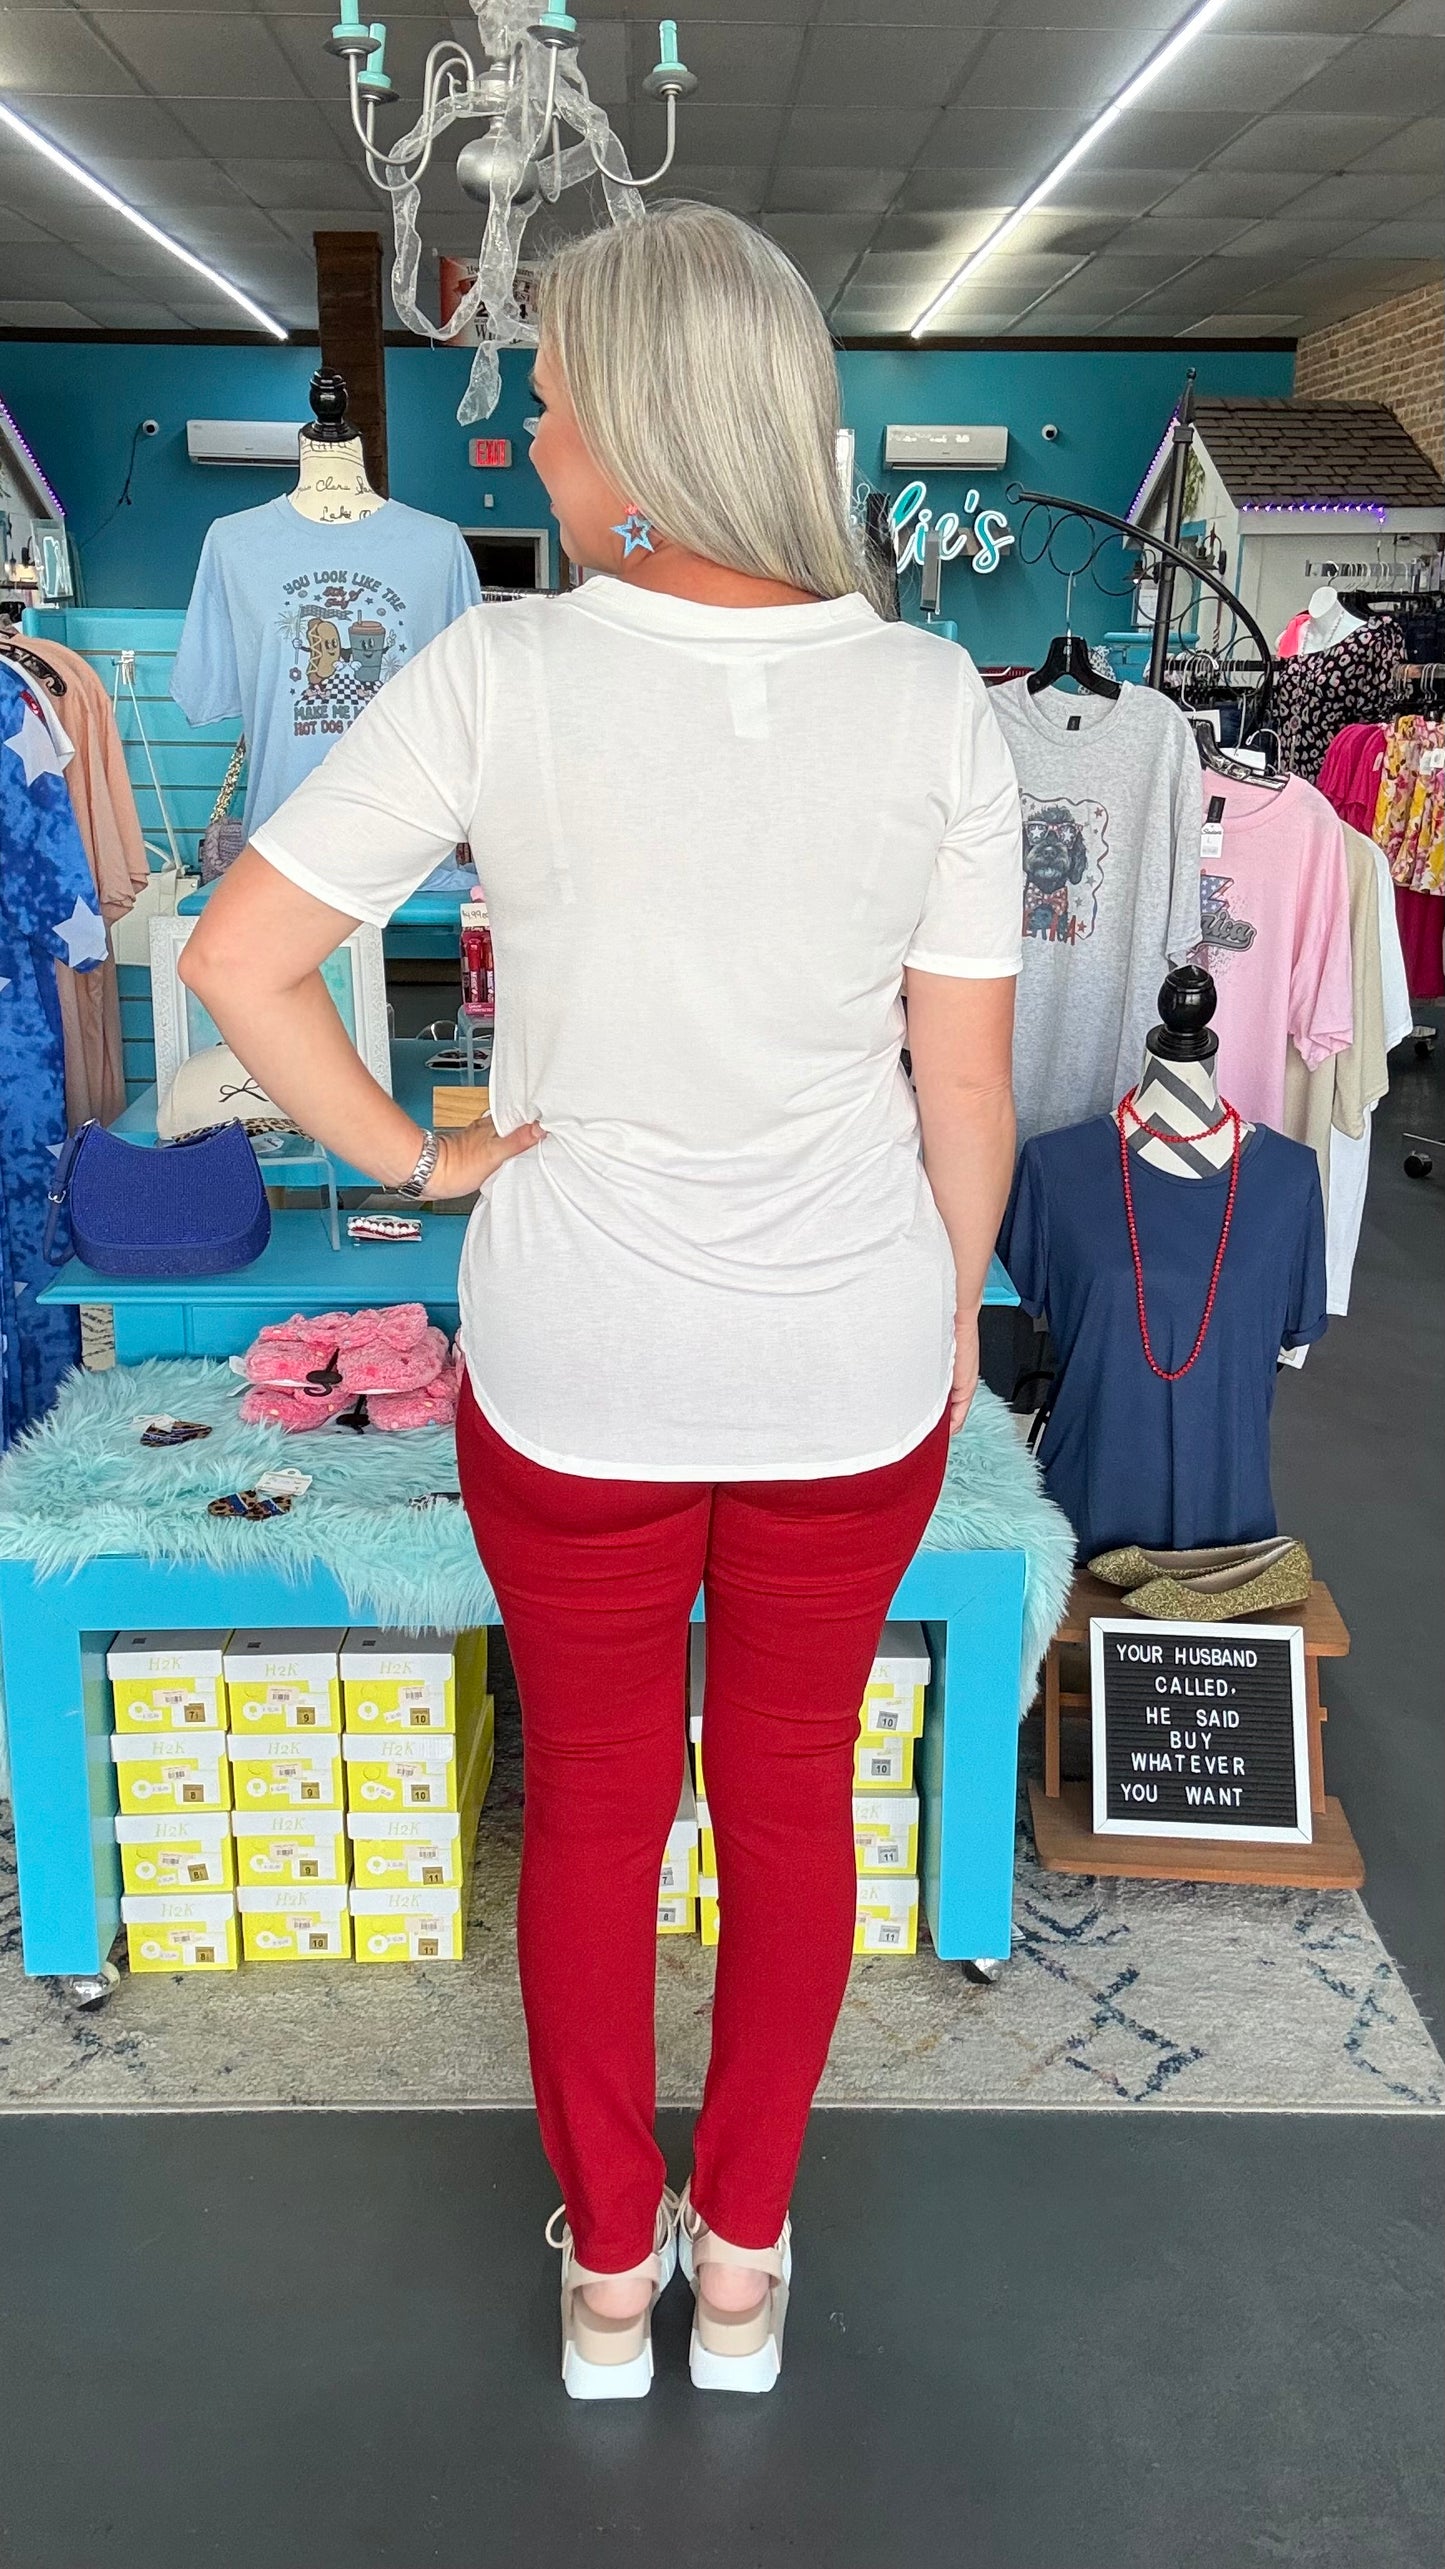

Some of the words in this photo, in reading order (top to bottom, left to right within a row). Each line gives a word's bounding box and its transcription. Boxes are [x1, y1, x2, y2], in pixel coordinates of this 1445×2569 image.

[476, 439, 506, 466] EXIT
[283, 574, 310, 595] YOU
[313, 570, 348, 584] LOOK
[352, 572, 382, 592] LIKE
[381, 587, 406, 612] THE
[294, 705, 329, 721] MAKE
[332, 704, 351, 719] ME
[294, 721, 317, 736] HOT
[320, 720, 344, 734] DOG
[1116, 1643, 1163, 1664] YOUR
[1174, 1647, 1258, 1668] HUSBAND
[415, 1715, 426, 1723] 10
[882, 1718, 893, 1727] 10
[1146, 1706, 1172, 1725] HE
[1196, 1709, 1240, 1729] SAID
[1170, 1730, 1212, 1750] BUY
[876, 1765, 887, 1773] 10
[1131, 1752, 1246, 1776] WHATEVER
[415, 1792, 426, 1800] 10
[1120, 1783, 1158, 1803] YOU
[1185, 1785, 1243, 1807] WANT
[883, 1853, 894, 1862] 11
[428, 1874, 439, 1882] 11
[885, 1933, 895, 1942] 11
[313, 1940, 324, 1948] 10
[424, 1947, 434, 1955] 11
